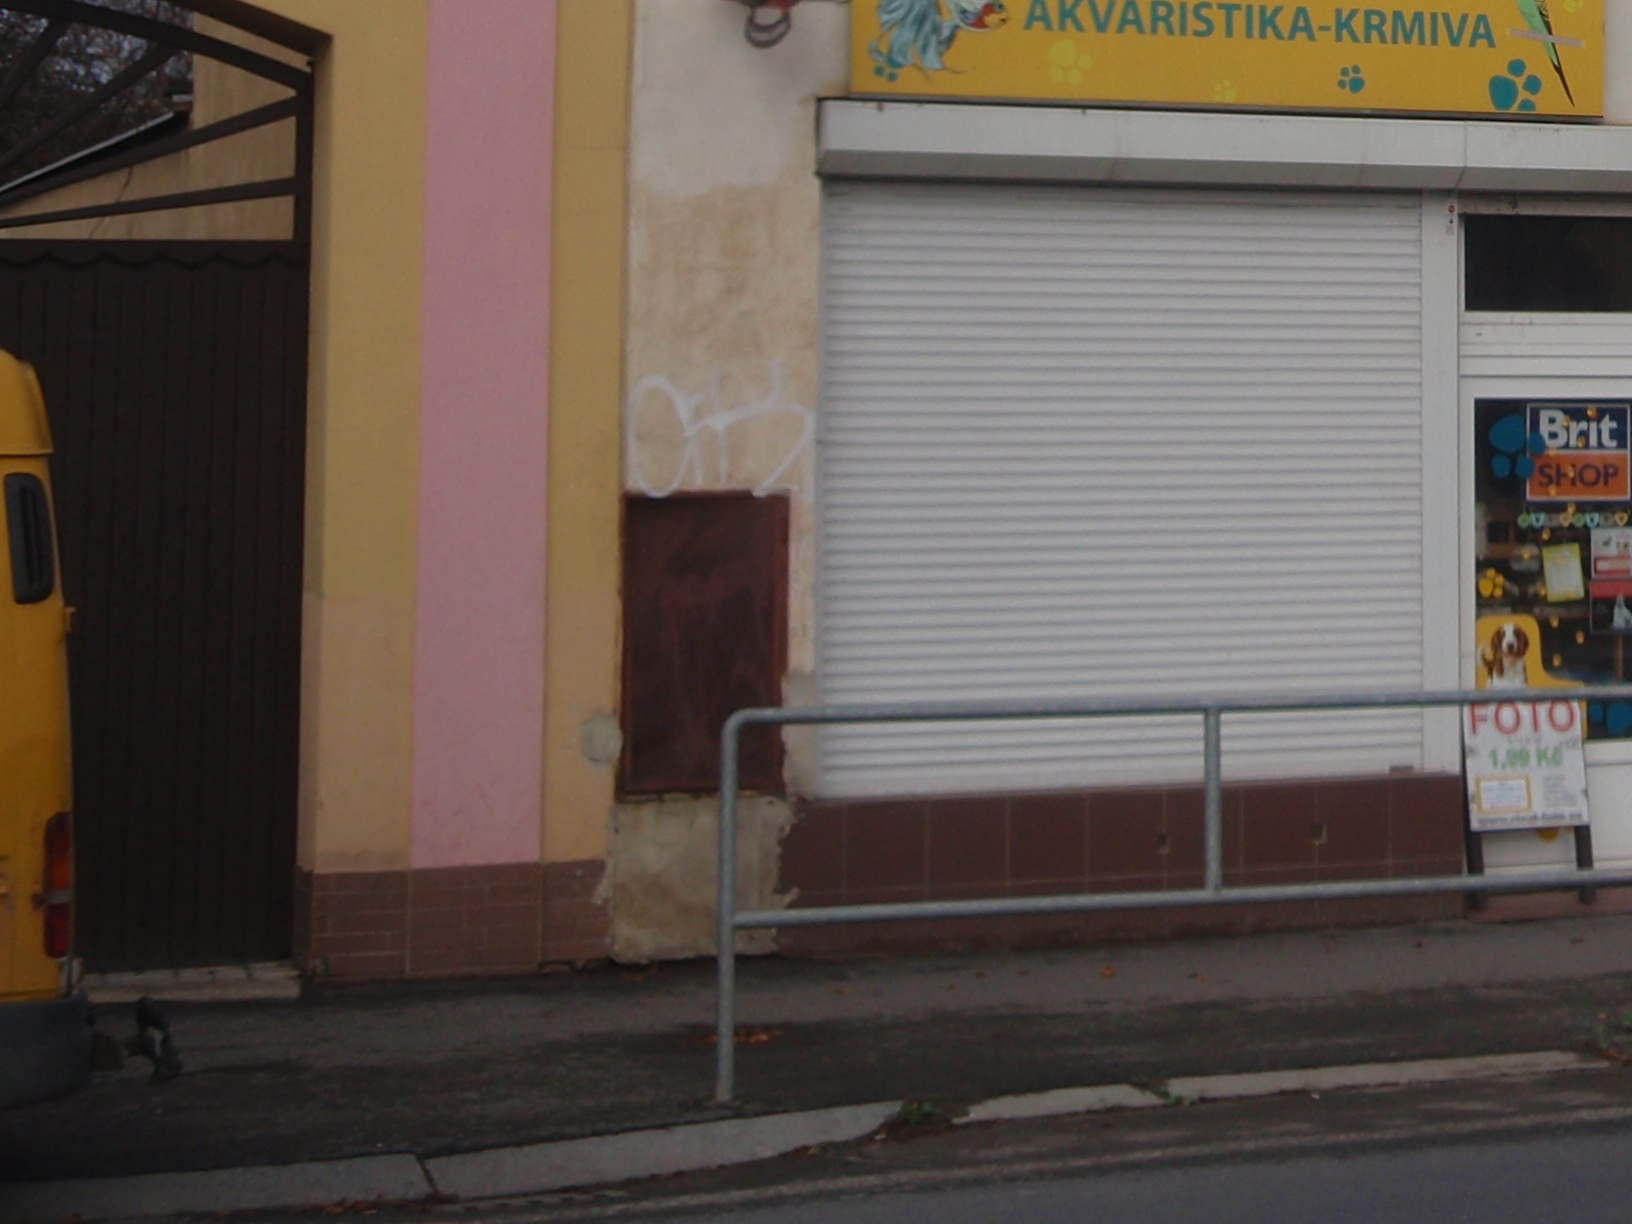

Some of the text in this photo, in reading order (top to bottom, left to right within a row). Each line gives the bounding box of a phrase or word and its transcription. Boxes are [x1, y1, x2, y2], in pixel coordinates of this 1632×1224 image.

[1539, 408, 1619, 448] Brit
[1538, 463, 1619, 488] SHOP
[1469, 699, 1576, 736] FOTO
